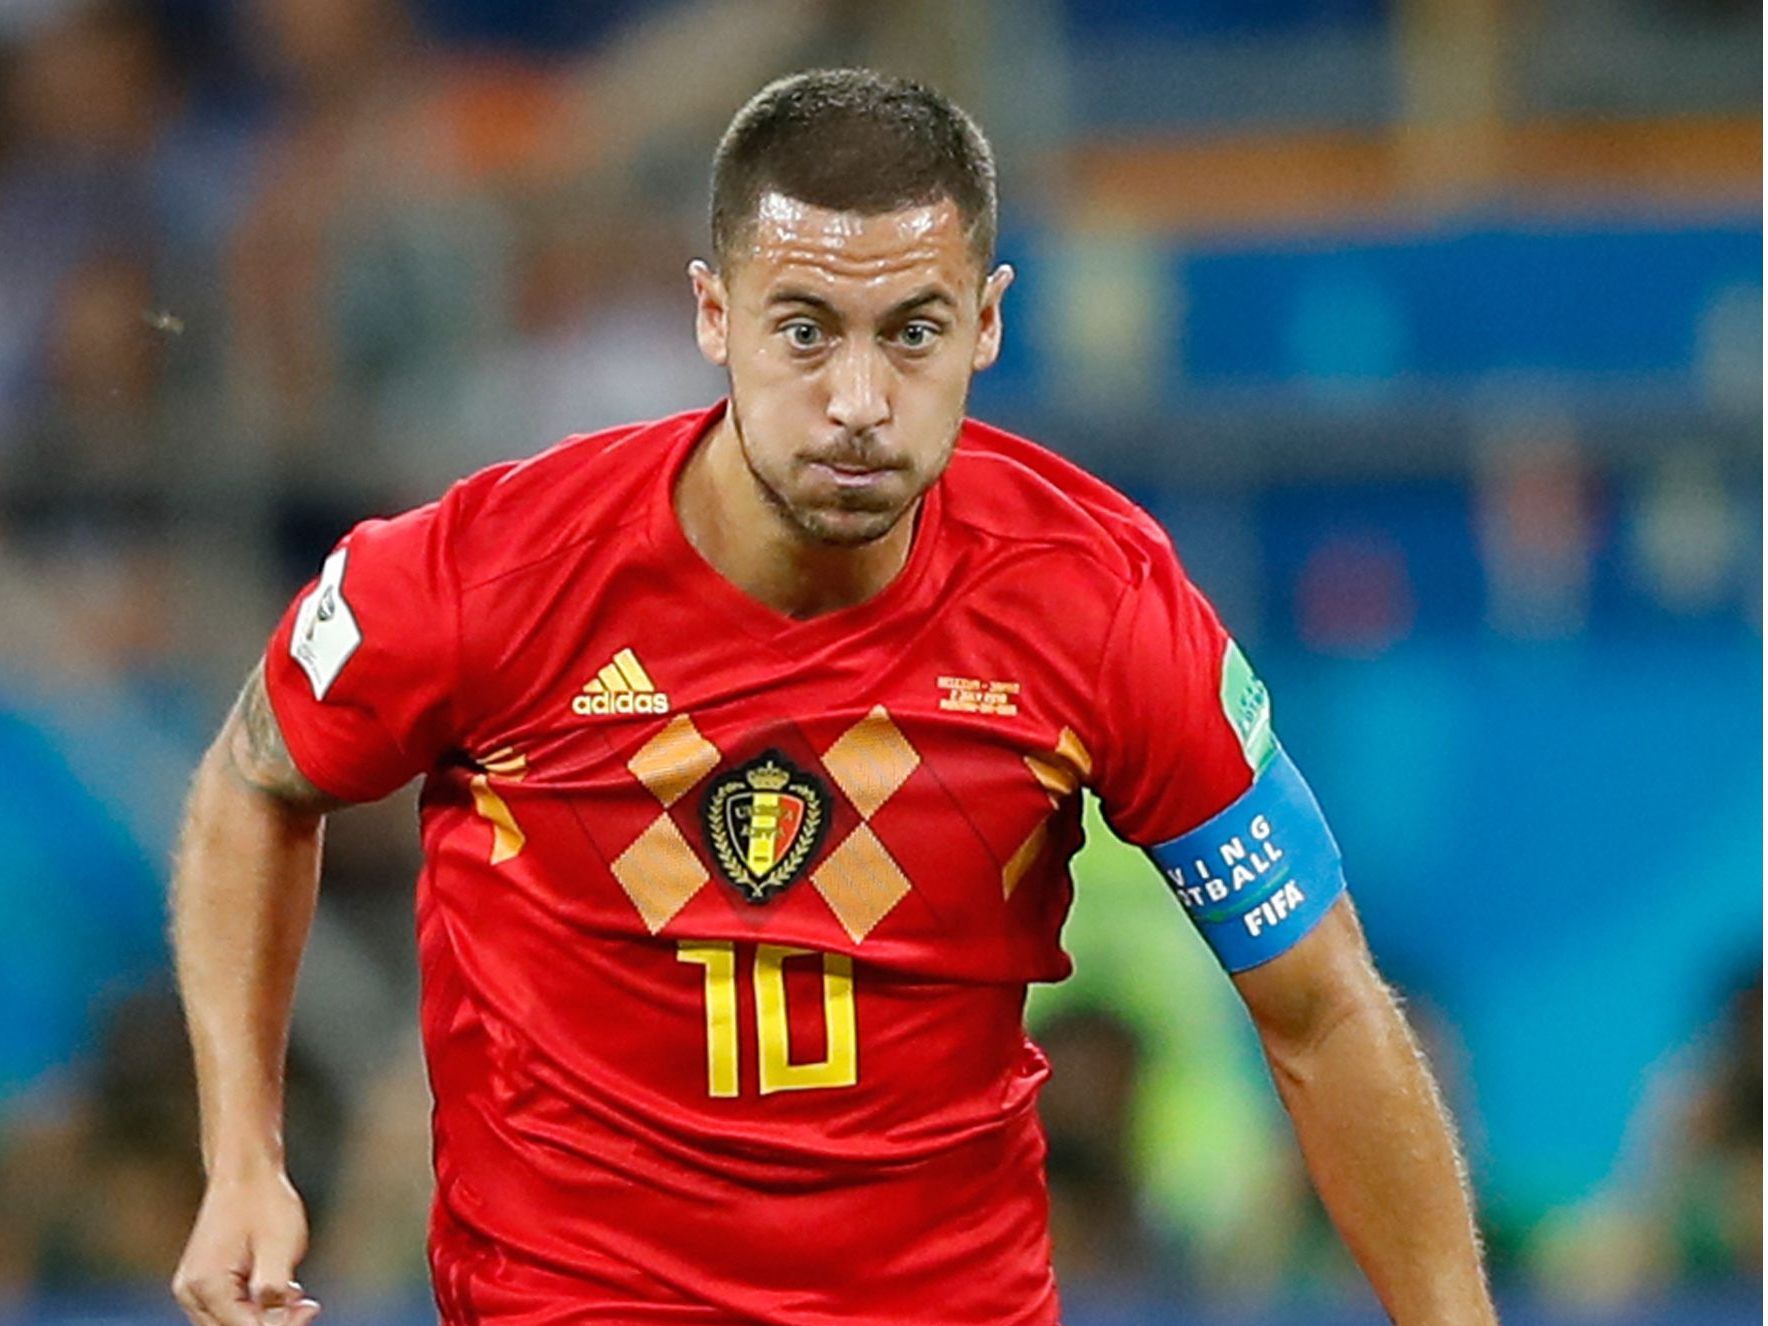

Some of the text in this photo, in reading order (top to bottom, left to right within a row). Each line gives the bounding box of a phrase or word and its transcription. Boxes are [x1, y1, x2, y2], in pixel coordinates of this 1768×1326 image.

[571, 692, 669, 715] adidas
[1243, 878, 1306, 937] FIFA
[676, 939, 858, 1097] 10
